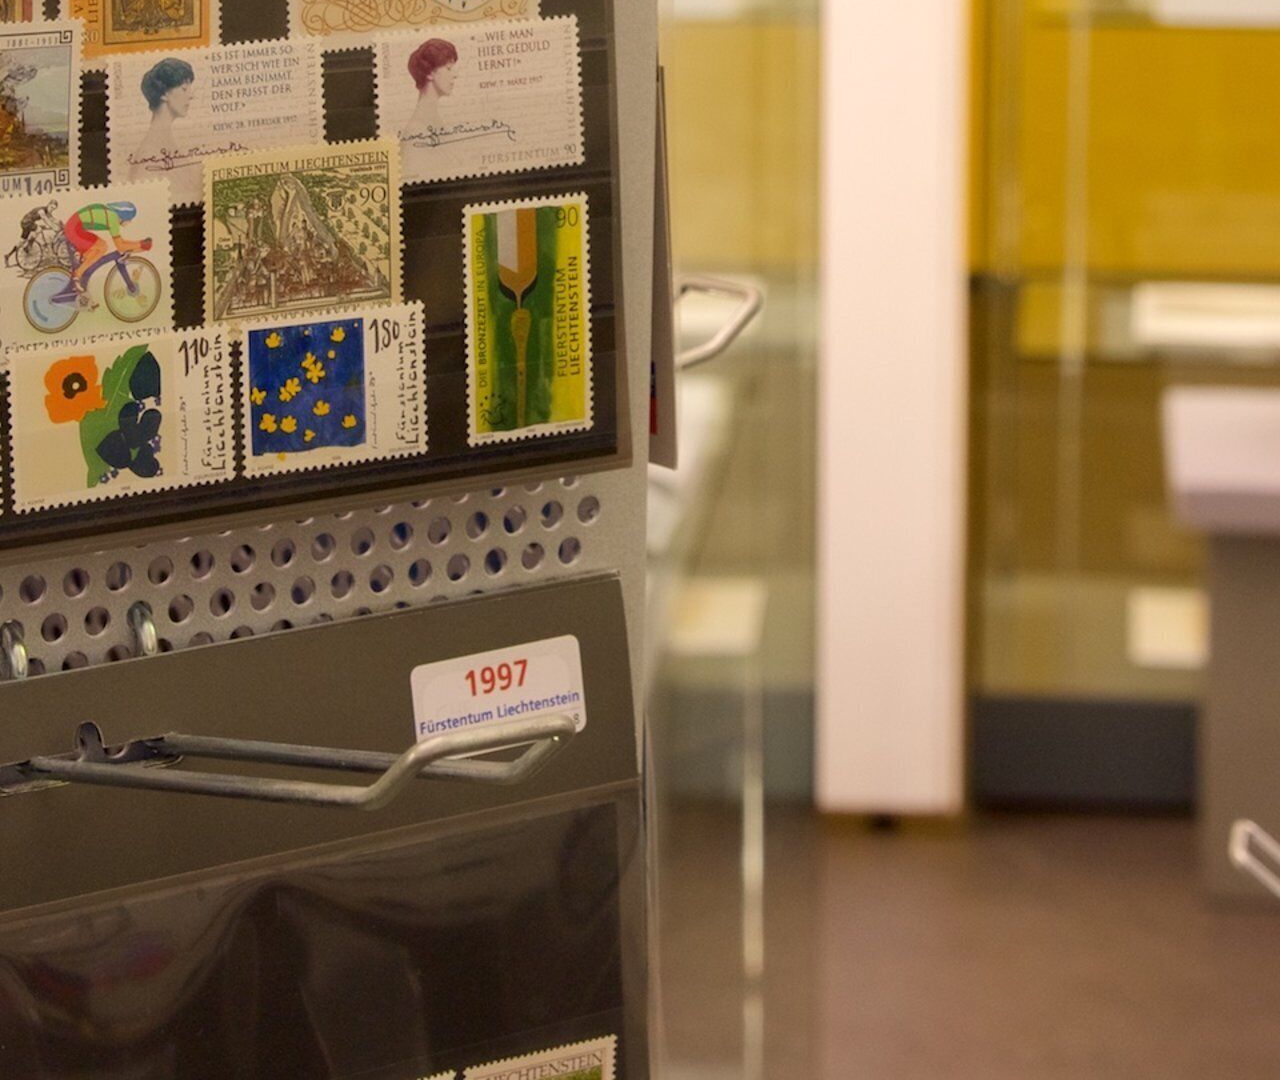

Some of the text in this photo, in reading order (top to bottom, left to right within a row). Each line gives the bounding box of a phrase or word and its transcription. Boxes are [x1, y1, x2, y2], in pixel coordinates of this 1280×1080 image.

[509, 28, 534, 39] MAN
[225, 45, 293, 60] IST IMMER SO
[478, 40, 550, 57] HIER GEDULD
[211, 57, 300, 74] WER SICH WIE EIN
[211, 76, 242, 87] LAMM
[211, 84, 292, 101] DEN FRISST DER
[294, 150, 389, 170] LIECHTENSTEIN
[564, 143, 577, 156] 90
[359, 185, 387, 206] 90
[555, 205, 579, 229] 90
[475, 228, 488, 388] DIE BRONZEZEIT IN EUROPA
[568, 255, 580, 375] LIECHTENSTEIN
[555, 268, 568, 377] FUERSTENTUM
[404, 311, 419, 445] Liechtenstein
[209, 333, 227, 471] Liechtenstein
[465, 659, 529, 697] 1997
[420, 691, 580, 735] Fürstentum Liechtenstein
